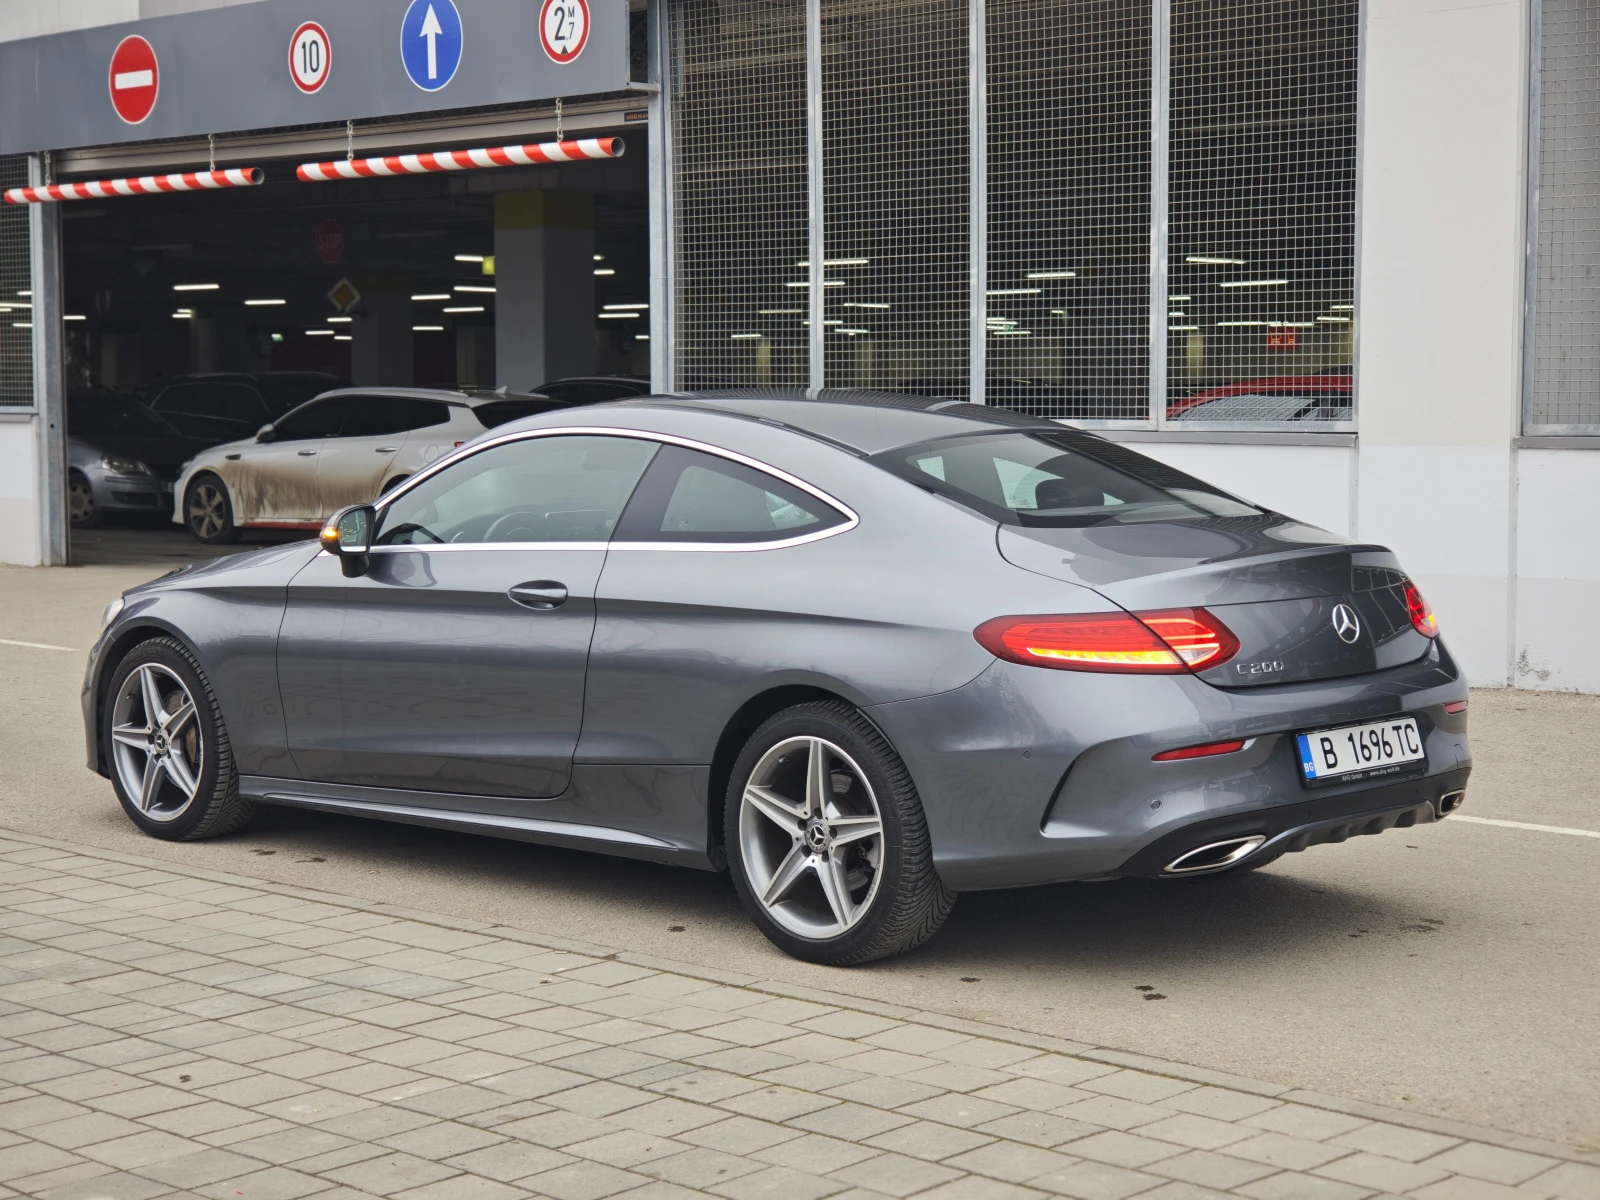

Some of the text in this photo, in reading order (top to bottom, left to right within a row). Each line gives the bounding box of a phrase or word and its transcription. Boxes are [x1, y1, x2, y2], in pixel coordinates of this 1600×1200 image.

[301, 39, 320, 74] 10
[317, 233, 341, 250] STOP
[1250, 661, 1284, 674] 200
[1319, 723, 1419, 769] B 1696 TC
[1303, 762, 1314, 773] BG
